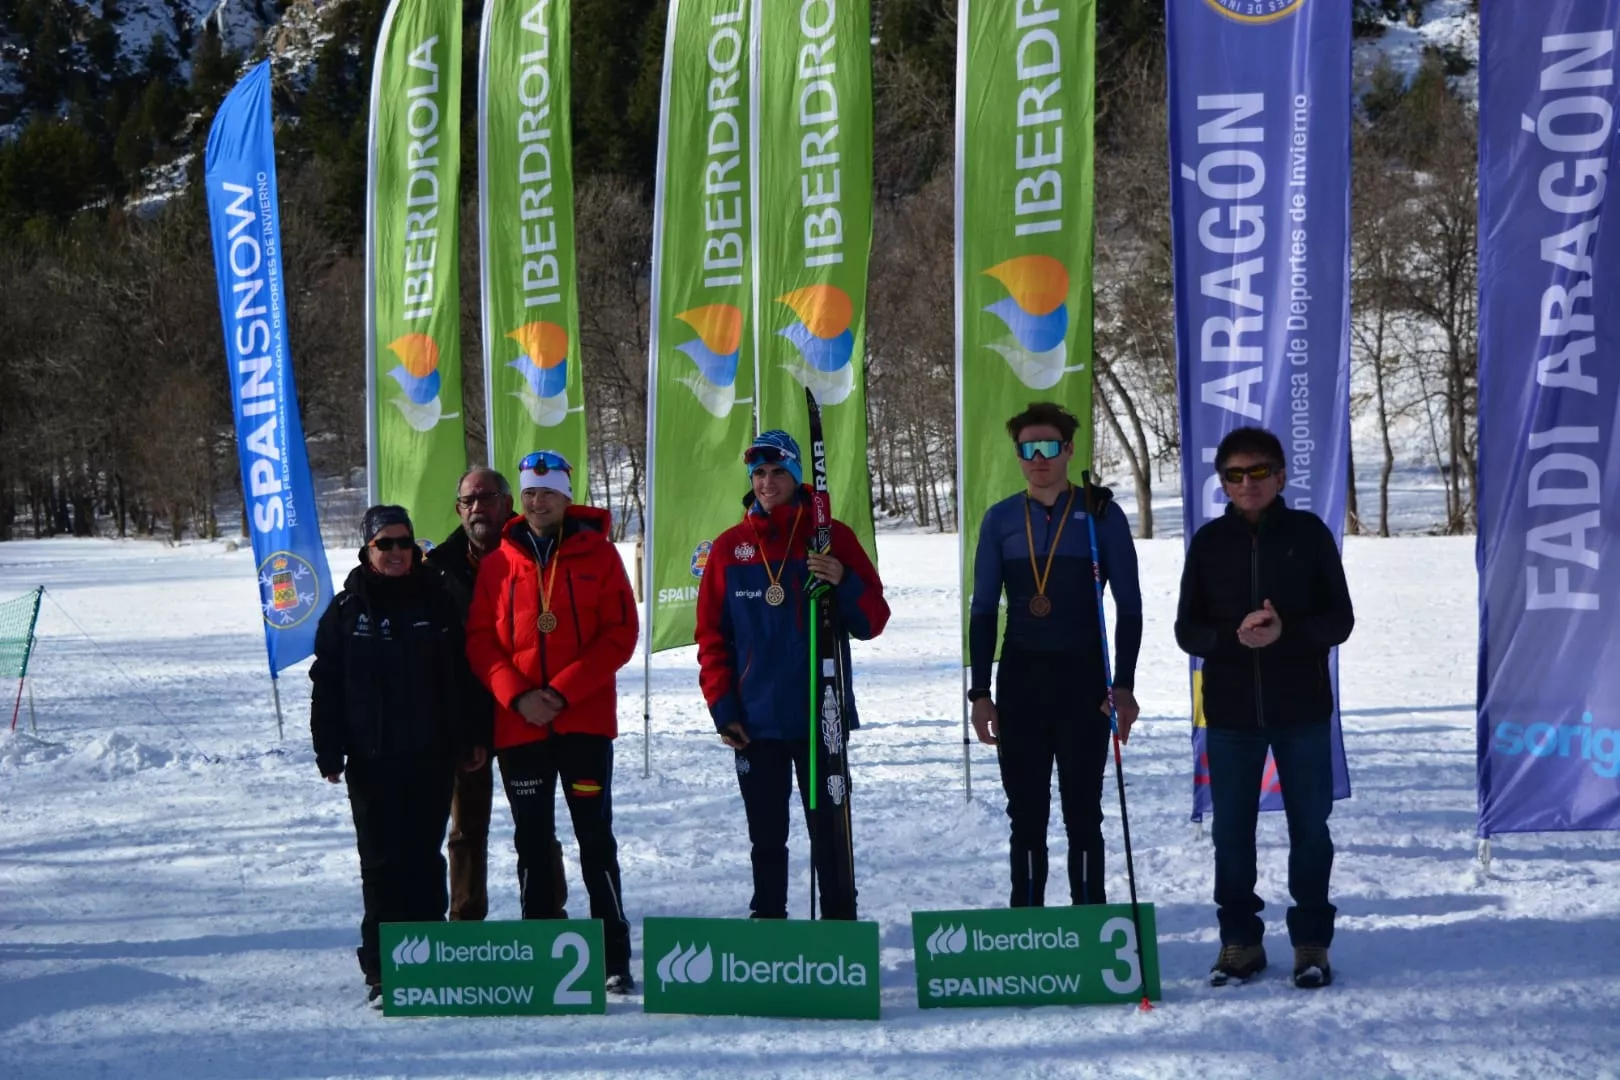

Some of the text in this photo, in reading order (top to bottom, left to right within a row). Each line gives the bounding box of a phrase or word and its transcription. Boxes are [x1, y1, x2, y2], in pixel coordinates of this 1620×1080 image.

[516, 0, 561, 306] IBERDROLA
[1289, 94, 1308, 187] Invierno
[256, 171, 273, 237] INVIERNO
[403, 34, 440, 320] IBERDROLA
[1288, 194, 1308, 222] de
[266, 239, 277, 257] DE
[1181, 92, 1266, 421] ARAGÓN
[1286, 229, 1313, 331] Deportes
[267, 258, 281, 329] DEPORTES
[1521, 29, 1614, 611] FADI ARAGÓN
[221, 181, 286, 534] SPAINSNOW
[1286, 338, 1309, 366] de
[1288, 372, 1316, 490] Aragonesa
[285, 490, 299, 528] REAL
[1494, 711, 1620, 779] sorig
[435, 939, 534, 963] Iberdrola
[551, 931, 593, 1005] 2
[721, 952, 867, 987] Iberdrola
[973, 927, 1080, 952] Iberdrola
[1099, 916, 1143, 995] 3
[392, 985, 535, 1007] SPAINSNOW
[928, 974, 1081, 998] SPAINSNOW
